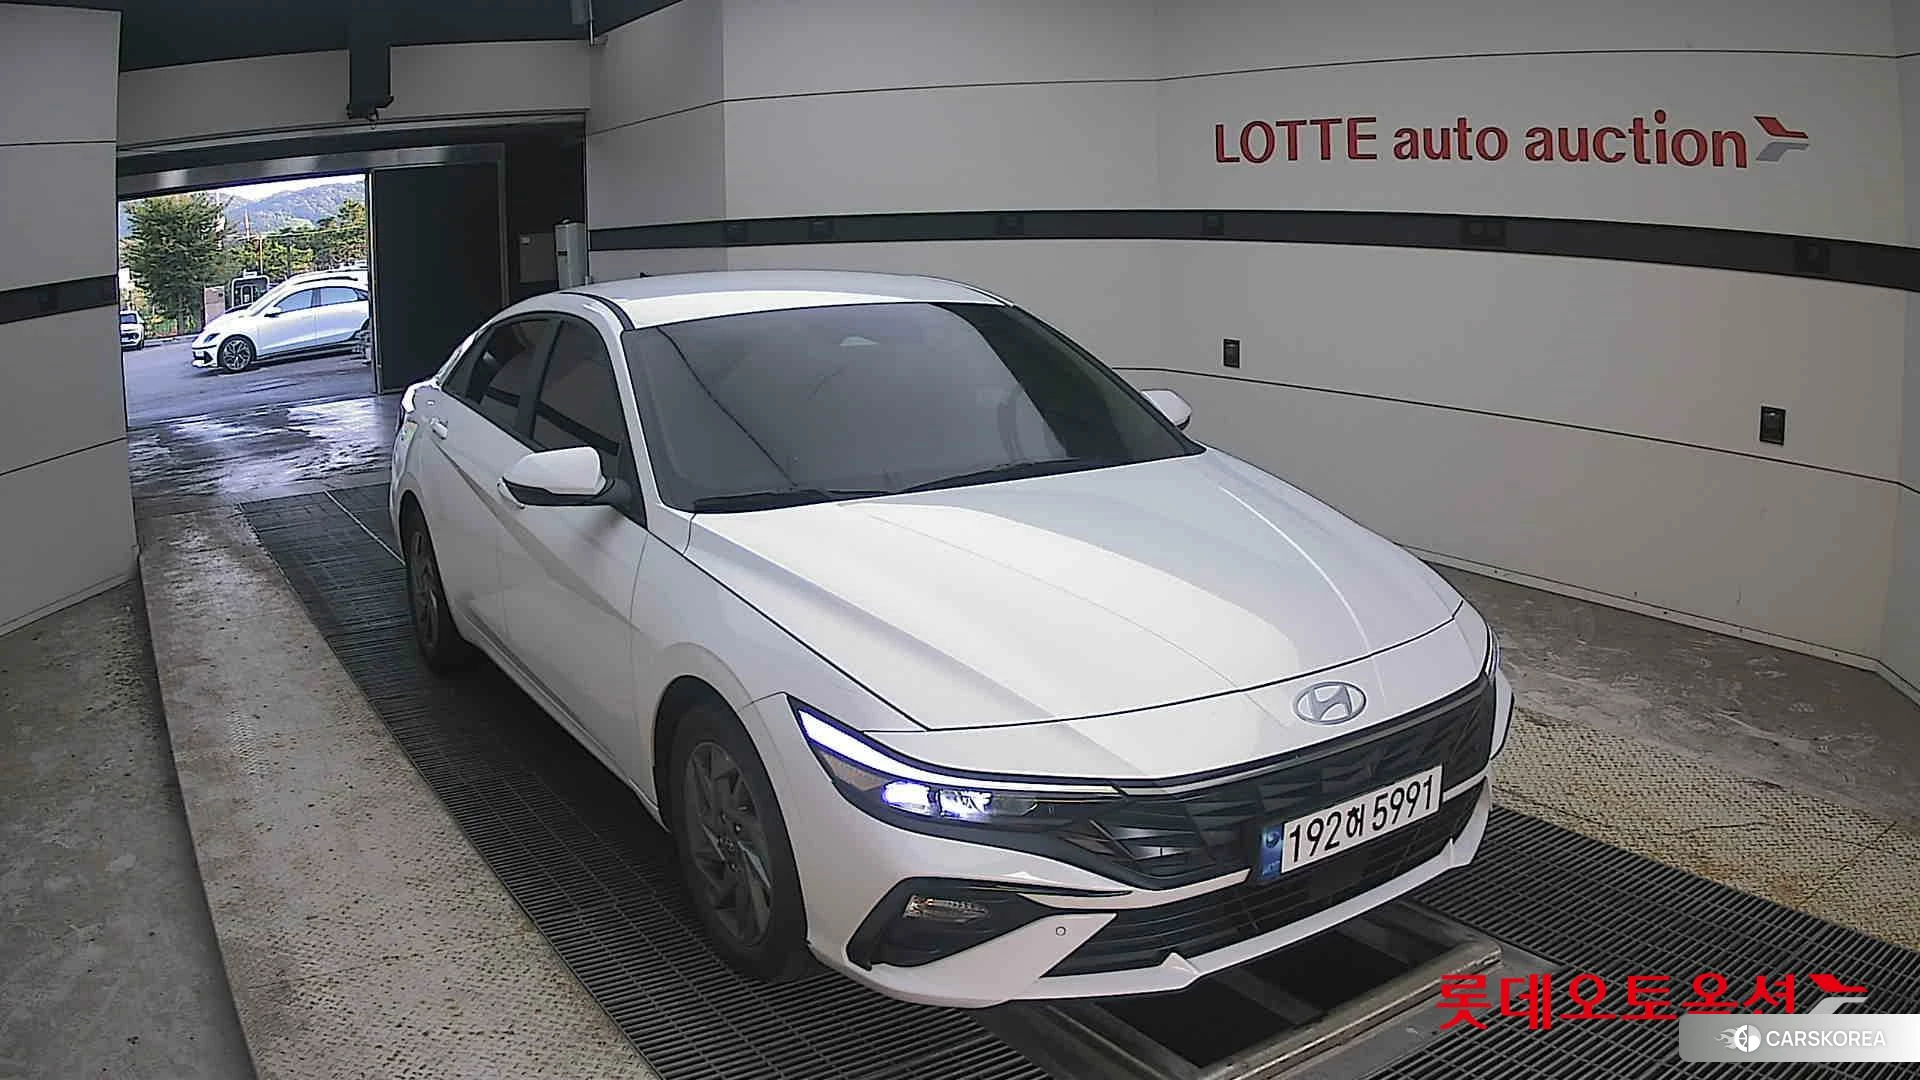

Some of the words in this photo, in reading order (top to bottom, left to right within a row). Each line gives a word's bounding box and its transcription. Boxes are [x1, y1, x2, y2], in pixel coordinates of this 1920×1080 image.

[1215, 117, 1378, 164] LOTTE
[1393, 117, 1508, 161] auto
[1525, 110, 1748, 168] auction
[1289, 803, 1366, 863] 192허
[1372, 774, 1433, 831] 5991
